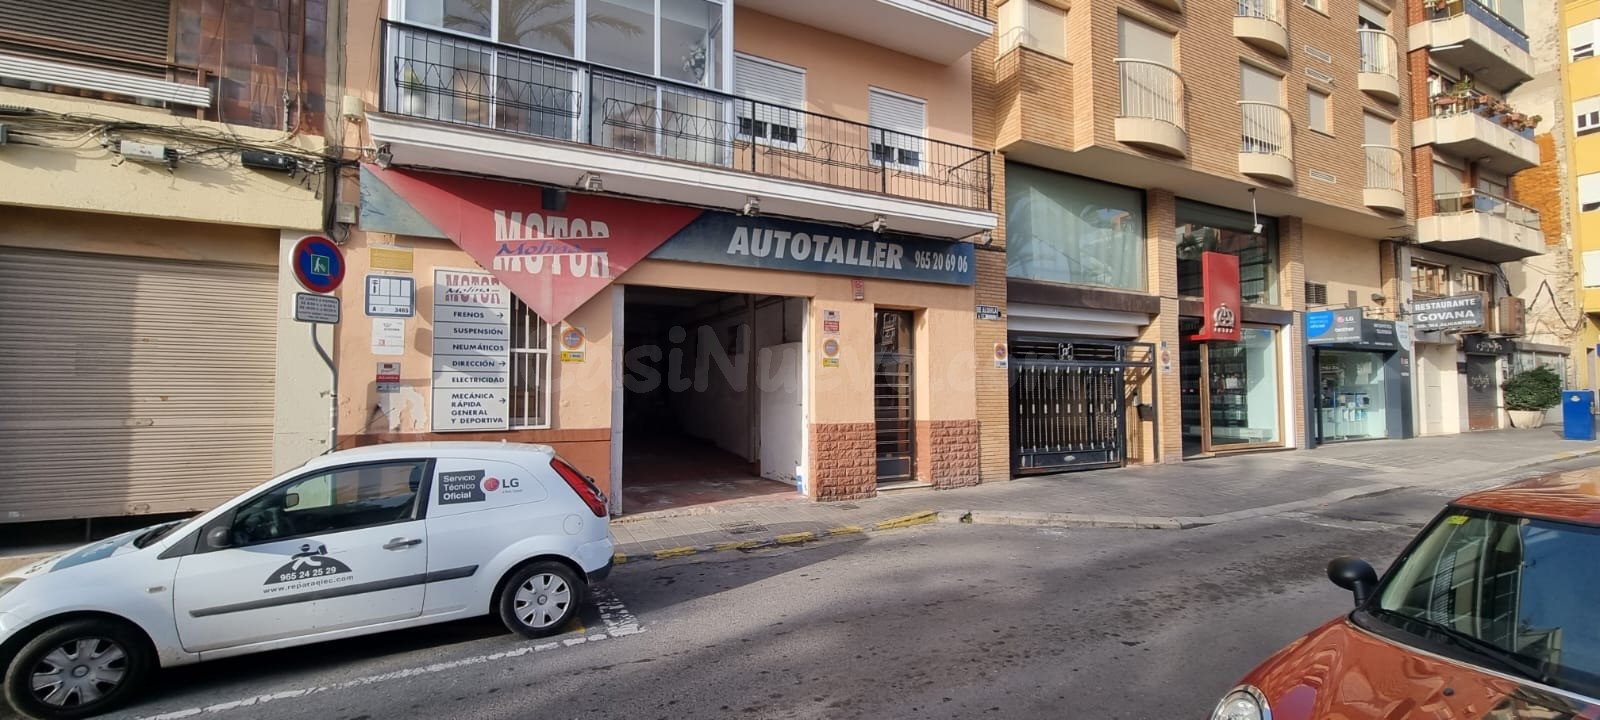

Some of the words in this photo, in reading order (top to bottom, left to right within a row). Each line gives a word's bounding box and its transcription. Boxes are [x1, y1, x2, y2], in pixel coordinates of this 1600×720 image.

[493, 209, 610, 279] MOTOR
[727, 226, 904, 270] AUTOTALLER
[914, 250, 931, 269] 965
[932, 254, 944, 271] 20
[945, 254, 956, 272] 69
[957, 255, 968, 273] 06
[445, 274, 501, 304] MOTOR
[1415, 298, 1476, 311] RESTAURANTE
[453, 311, 485, 319] FRENOS
[1416, 309, 1475, 322] GOVANA
[453, 327, 504, 336] SUSPENSIÓN
[452, 343, 505, 352] NEUMÁTICOS
[452, 360, 496, 368] DIRECCIÓN
[451, 376, 505, 384] ELECTRICIDAD
[451, 391, 495, 400] MECÁNICA
[443, 474, 476, 483] Servicio
[502, 478, 519, 488] LG
[443, 482, 476, 491] Técnico
[443, 491, 472, 500] Oficial
[280, 572, 297, 582] 965
[299, 570, 310, 579] 24
[312, 568, 323, 577] 25
[325, 566, 337, 574] 29
